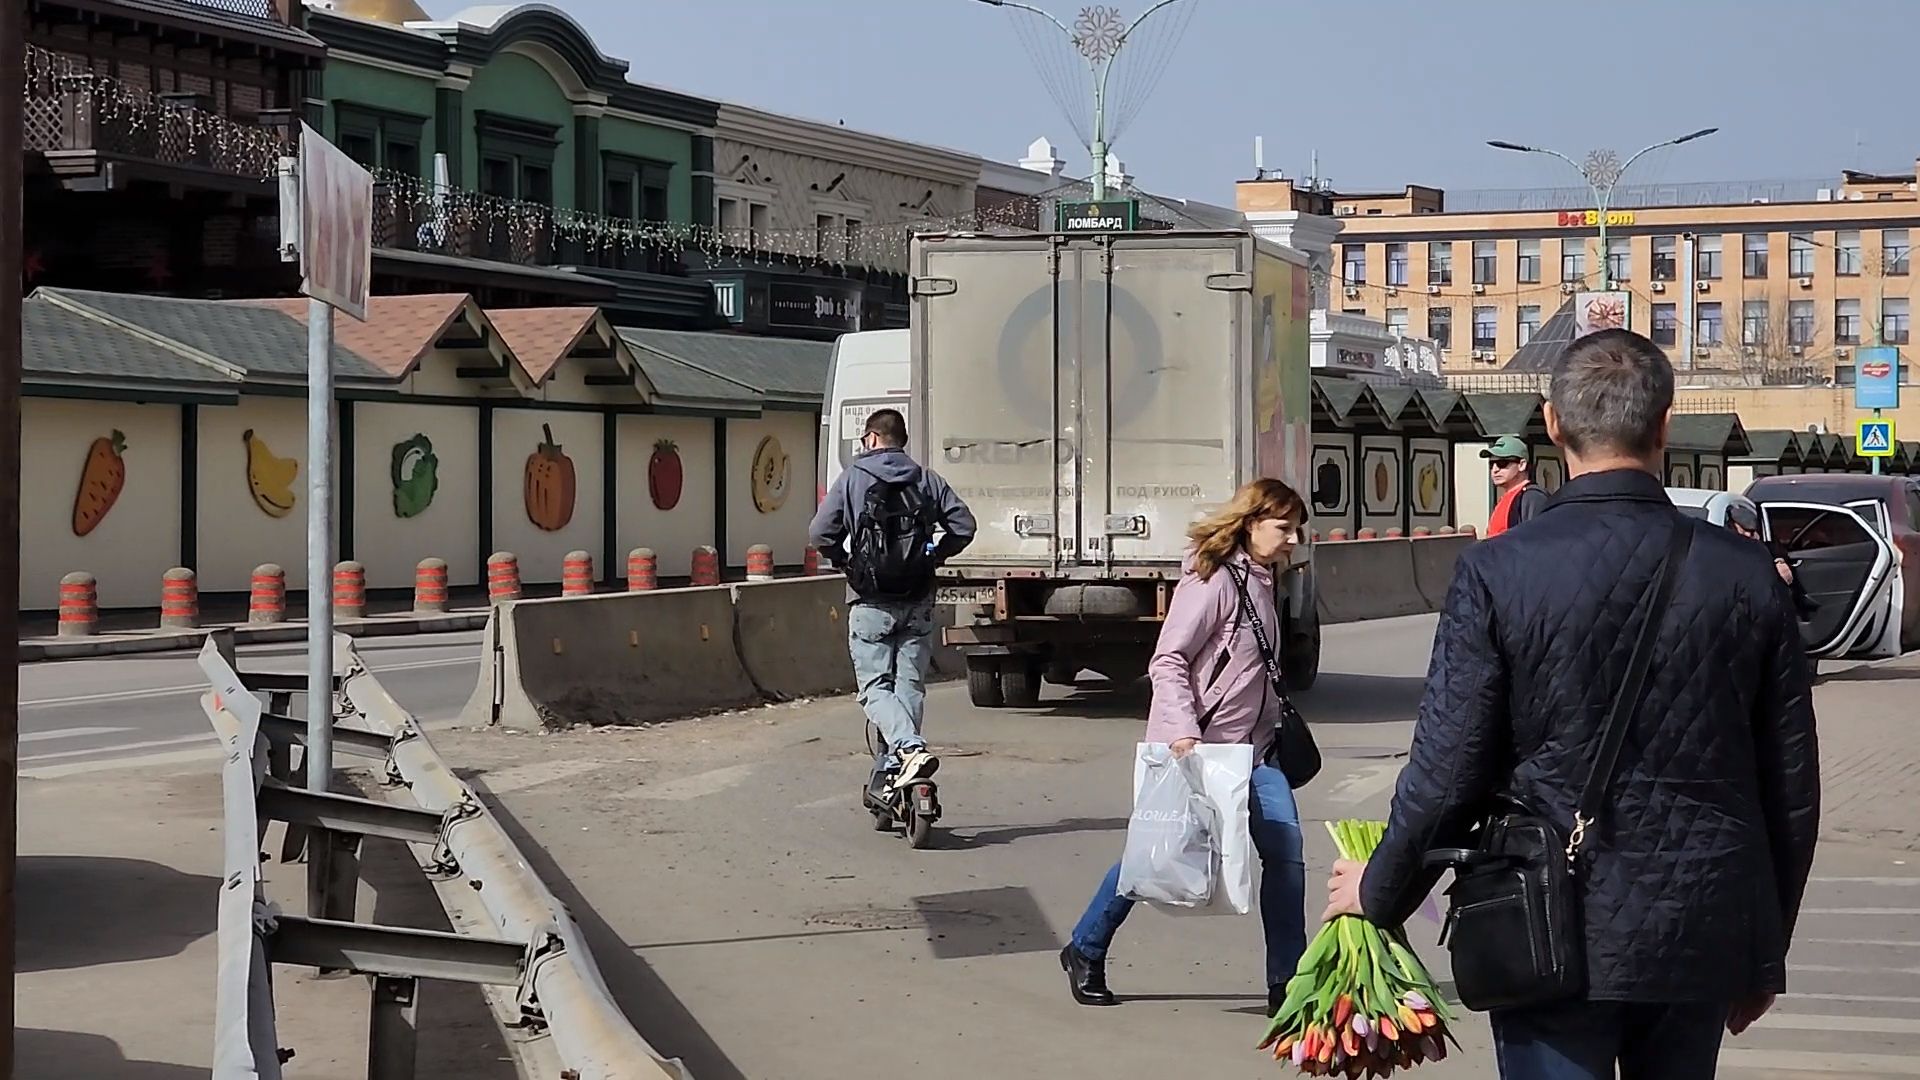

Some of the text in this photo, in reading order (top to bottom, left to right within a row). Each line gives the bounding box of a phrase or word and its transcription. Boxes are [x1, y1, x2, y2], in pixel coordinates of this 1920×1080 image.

[1067, 217, 1123, 230] ЛОМБАРД
[1117, 486, 1148, 499] ПОД
[1153, 483, 1201, 498] РУКОЙ
